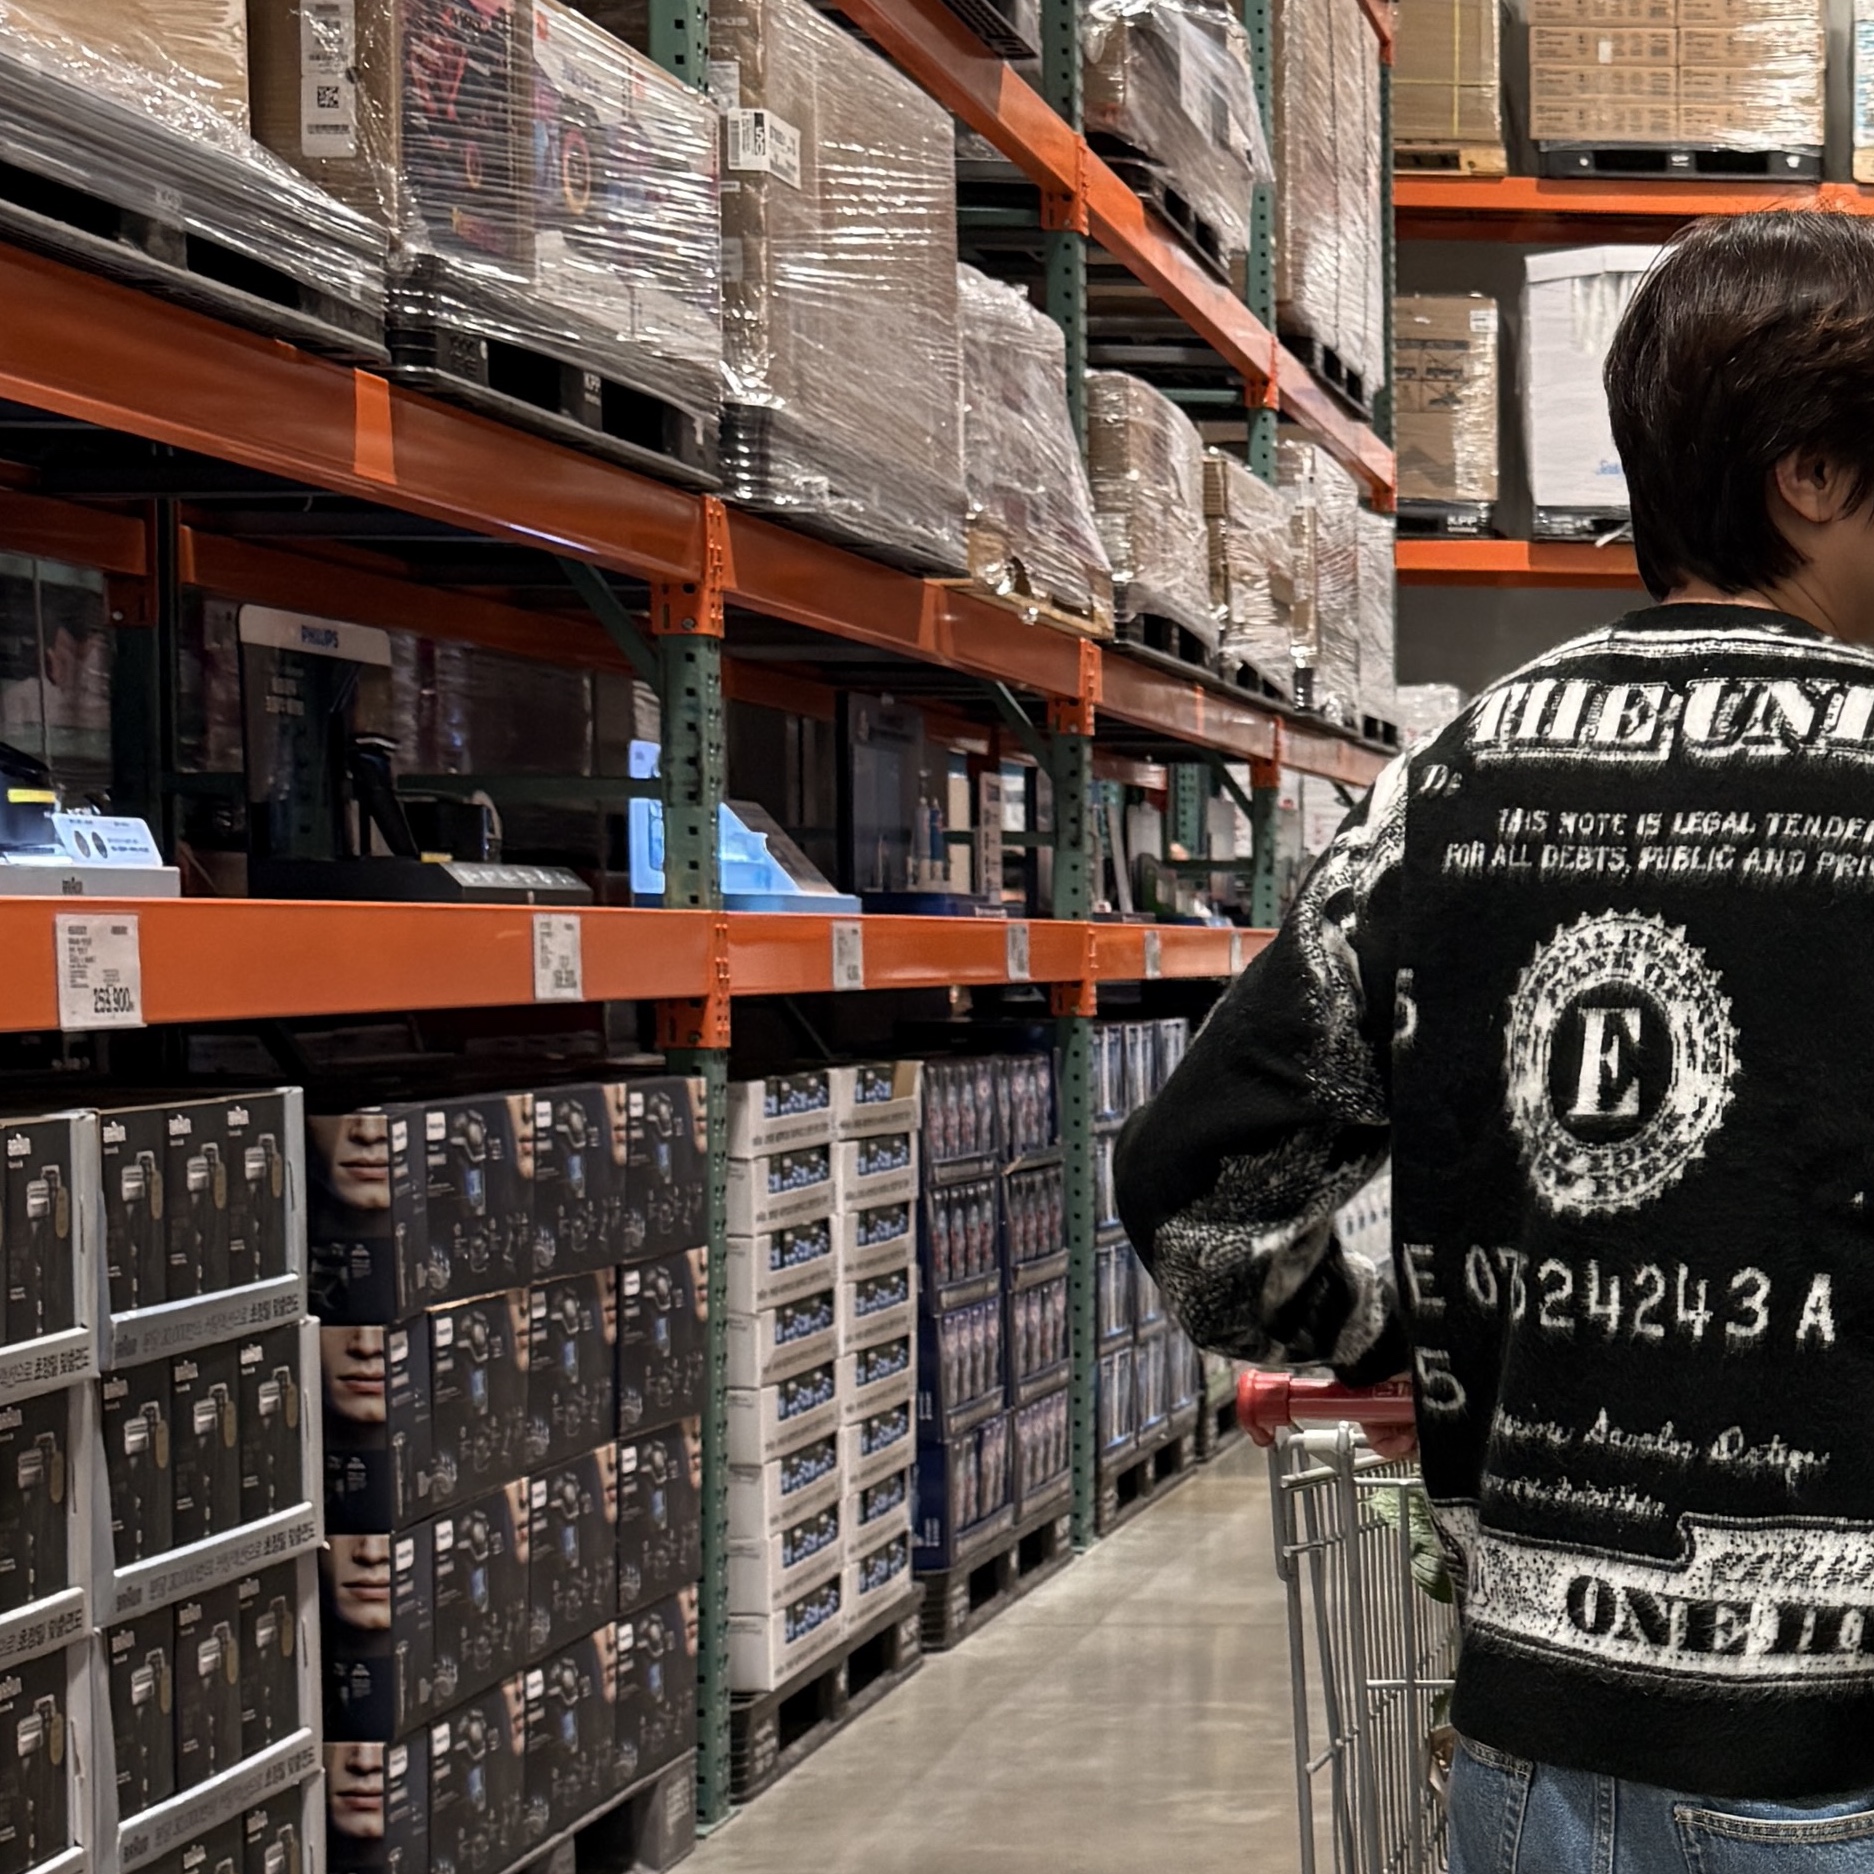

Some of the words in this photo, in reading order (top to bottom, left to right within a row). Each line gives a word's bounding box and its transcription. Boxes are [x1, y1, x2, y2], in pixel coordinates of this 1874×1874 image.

[1470, 678, 1672, 746] THE
[1498, 807, 1548, 837] THIS
[1559, 810, 1626, 840] NOTE
[1637, 812, 1659, 839] IS
[1673, 812, 1757, 838] LEGAL
[1443, 843, 1487, 873] FOR
[1492, 843, 1533, 869] ALL
[1639, 846, 1735, 875] PUBLIC
[1744, 848, 1805, 876] AND
[1567, 1006, 1641, 1116] E
[1403, 1243, 1446, 1308] E
[1797, 1272, 1835, 1342] A
[1415, 1346, 1467, 1411] 5
[1566, 1574, 1751, 1656] ONE
